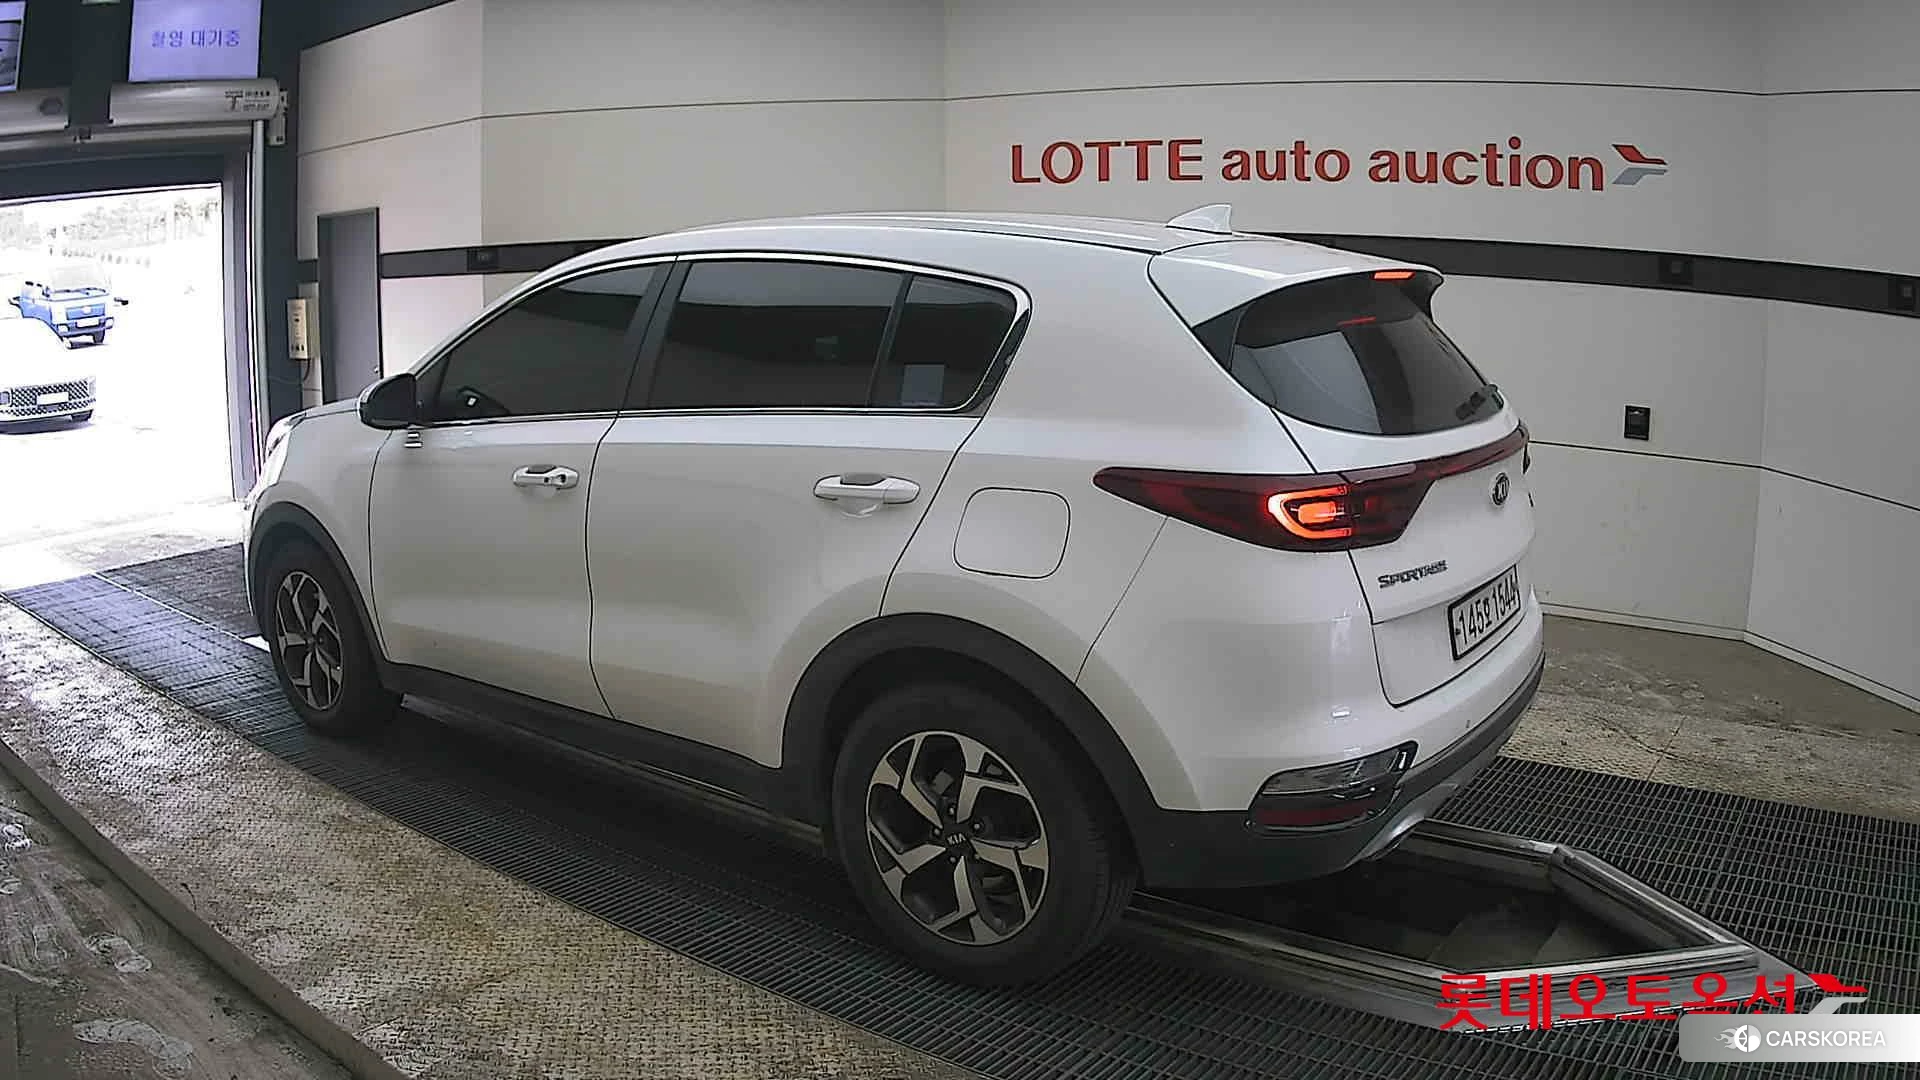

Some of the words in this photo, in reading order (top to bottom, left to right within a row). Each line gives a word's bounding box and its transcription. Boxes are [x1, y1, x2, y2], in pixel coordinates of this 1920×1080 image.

[191, 29, 241, 48] 대기중
[1010, 139, 1203, 185] LOTTE
[1221, 139, 1351, 183] auto
[1368, 136, 1605, 191] auction
